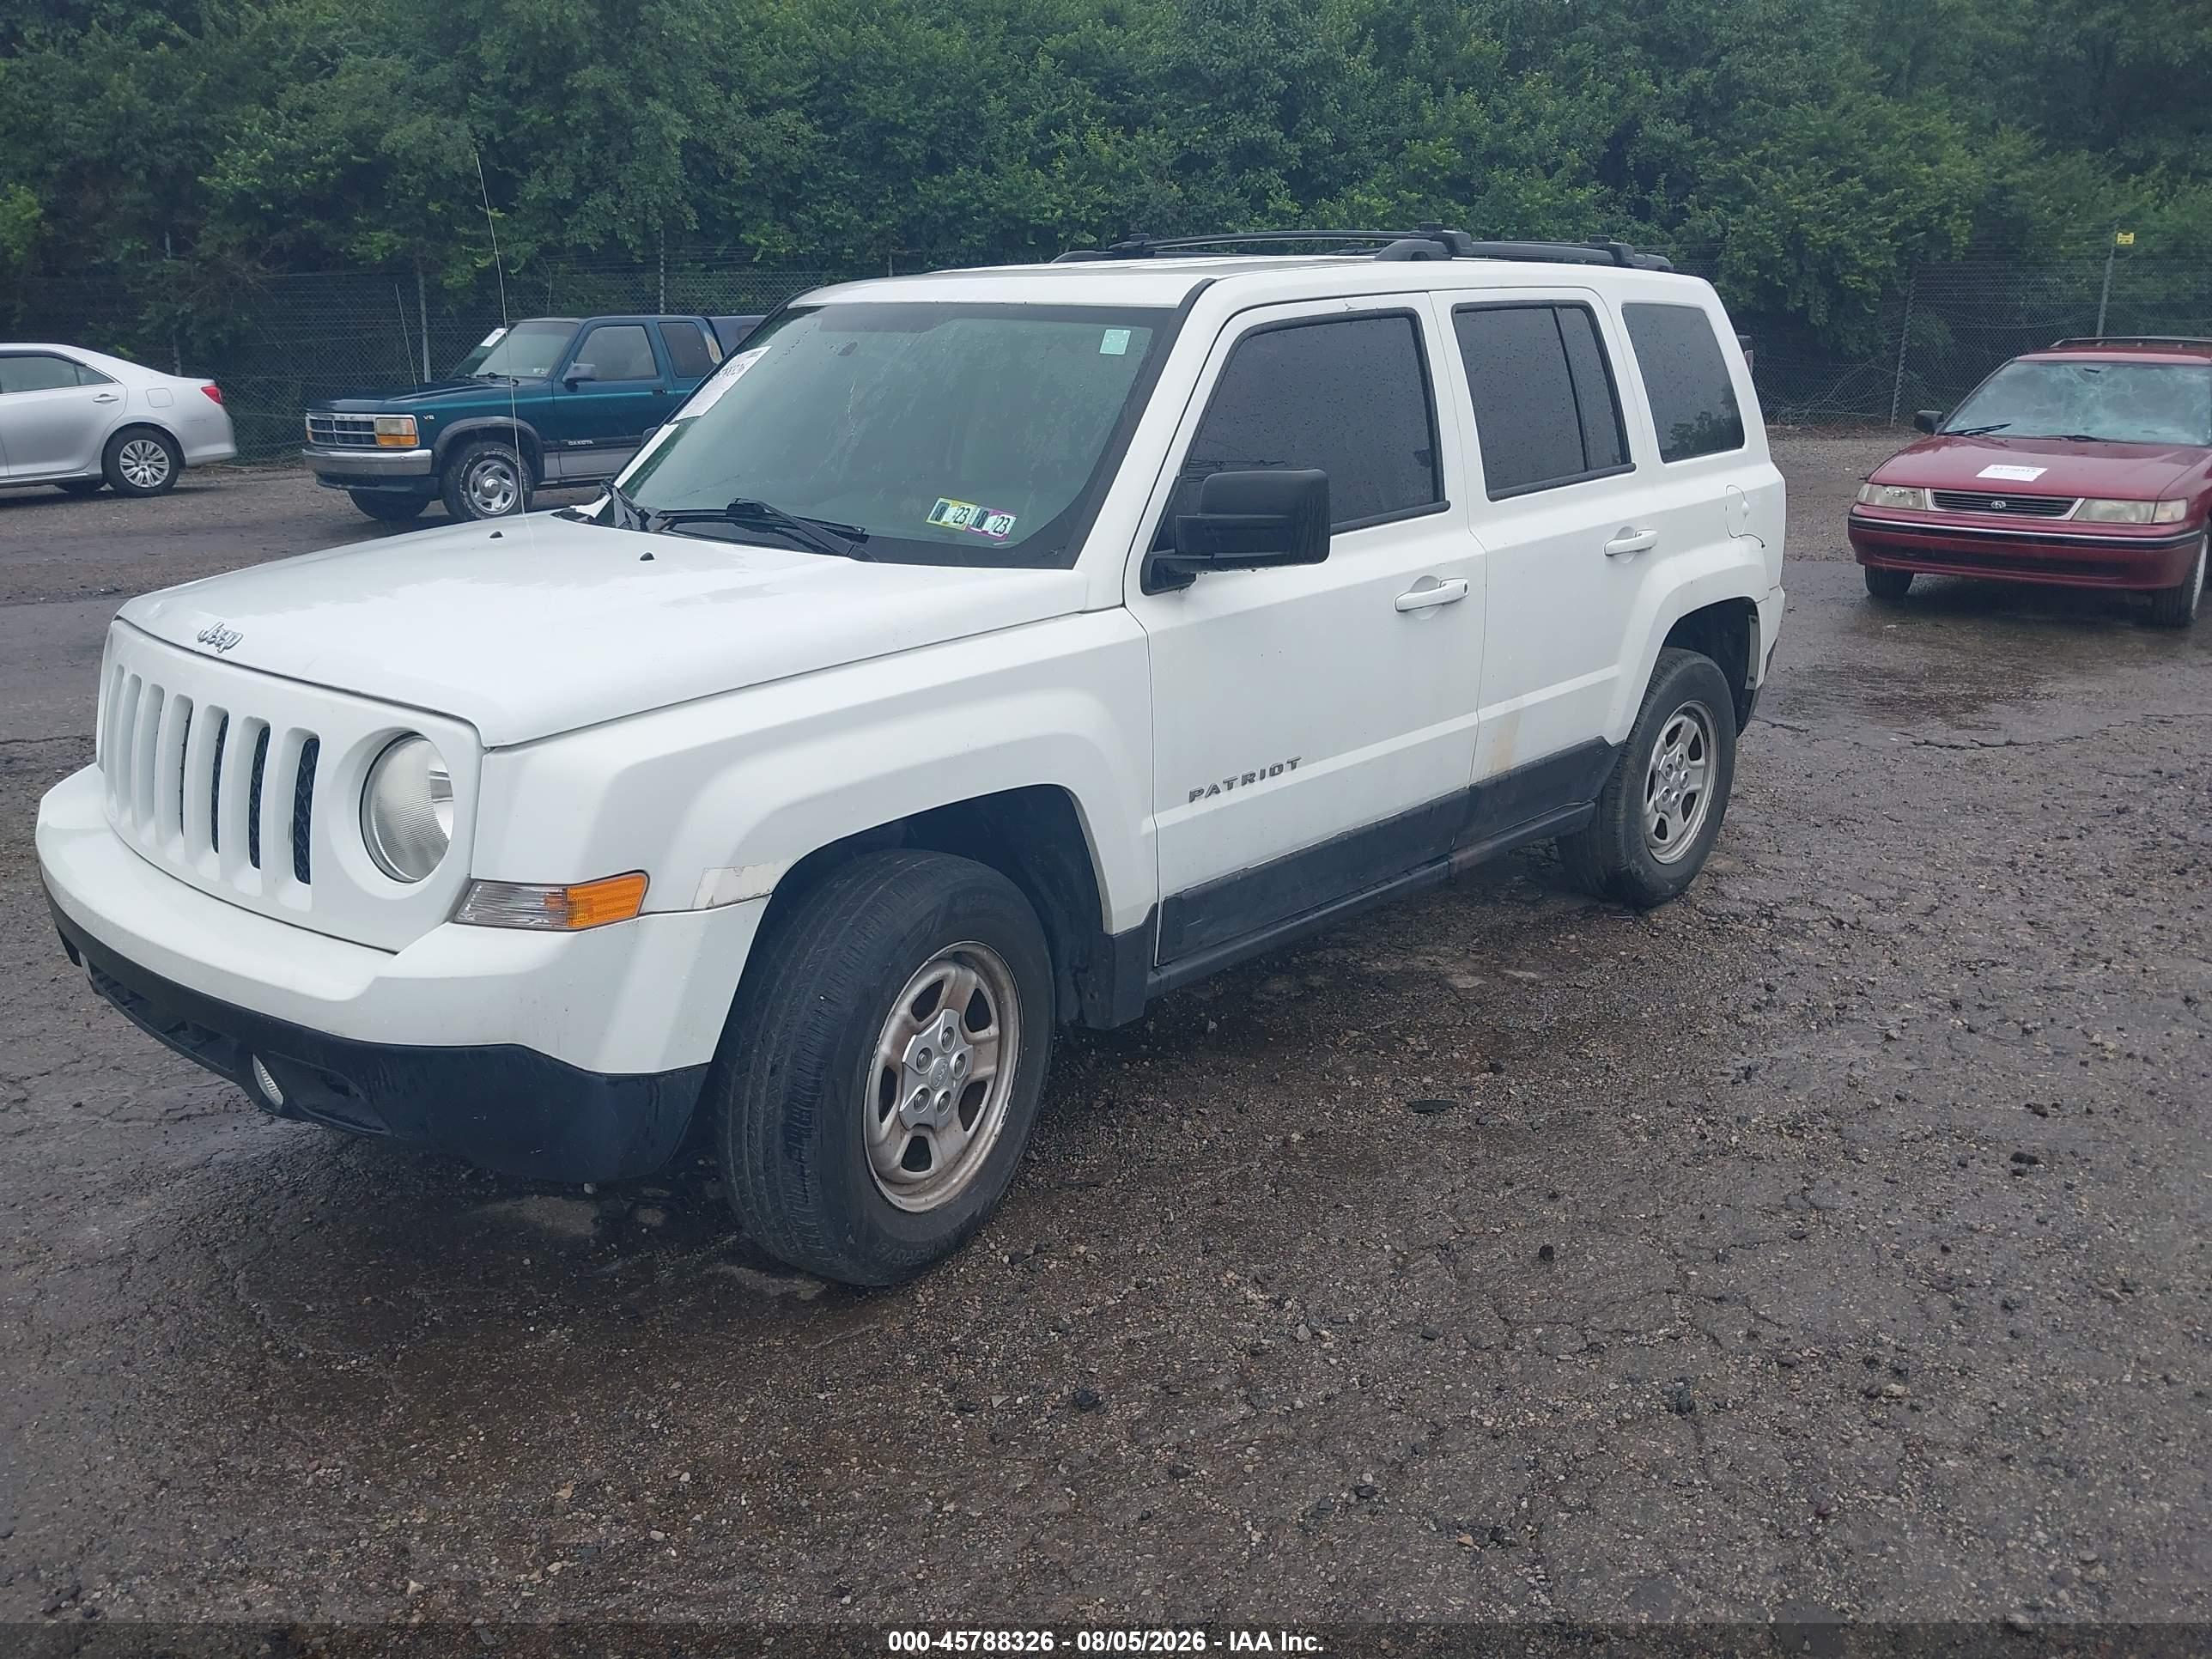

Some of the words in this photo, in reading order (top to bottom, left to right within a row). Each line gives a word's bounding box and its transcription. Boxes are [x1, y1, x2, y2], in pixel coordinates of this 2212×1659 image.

[935, 506, 946, 521] 8
[953, 507, 970, 524] 23
[994, 516, 1011, 534] 23
[197, 621, 244, 653] Jeep
[1188, 756, 1302, 803] PATRIOT
